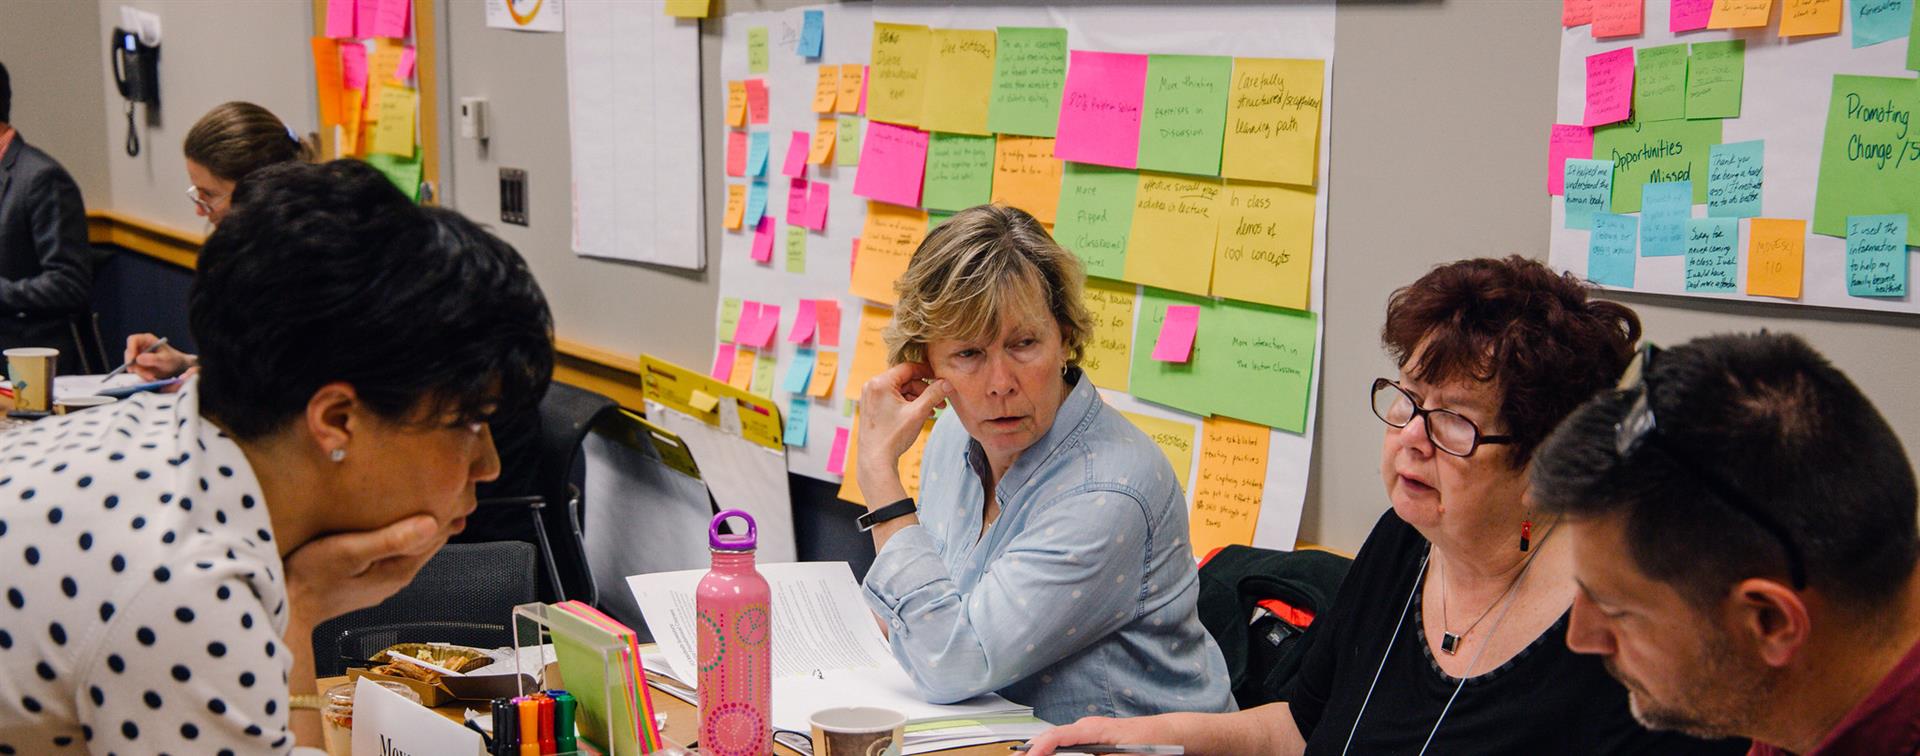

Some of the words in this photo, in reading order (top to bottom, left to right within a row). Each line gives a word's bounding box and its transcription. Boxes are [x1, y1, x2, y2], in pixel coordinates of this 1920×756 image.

[1238, 71, 1285, 91] Carefully
[1846, 92, 1910, 140] Promoting
[1275, 115, 1298, 136] path
[1612, 139, 1683, 173] Opportunities
[1712, 153, 1736, 166] Thank
[1847, 133, 1892, 170] Change
[1577, 165, 1597, 178] helped
[1598, 168, 1608, 177] me
[1650, 161, 1692, 183] Missed
[1174, 180, 1200, 192] small
[1247, 194, 1272, 209] class
[1565, 193, 1588, 205] human
[1236, 216, 1263, 236] demos
[1691, 226, 1710, 243] Sorry
[1861, 222, 1883, 235] used
[1884, 222, 1898, 236] the
[1849, 238, 1897, 255] information
[1224, 245, 1244, 262] cool
[1251, 249, 1291, 268] concepts
[1859, 257, 1876, 273] help
[378, 733, 412, 756] Mov
